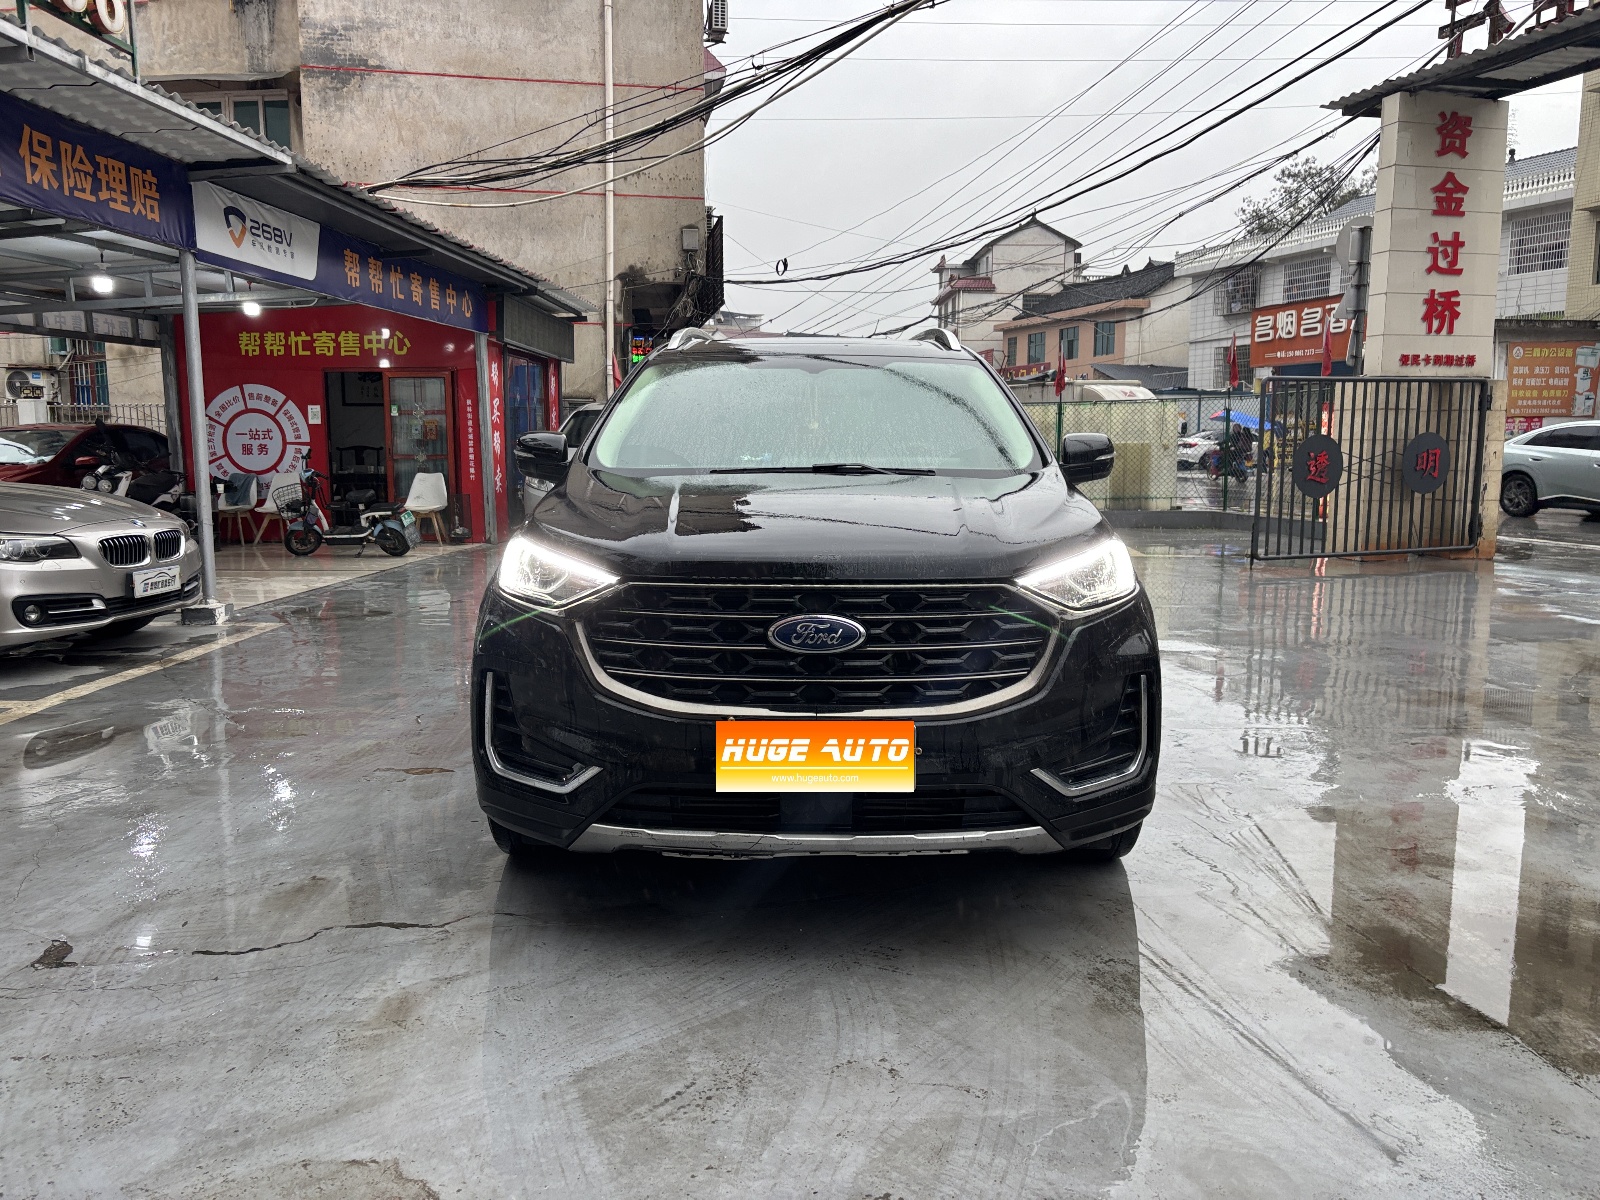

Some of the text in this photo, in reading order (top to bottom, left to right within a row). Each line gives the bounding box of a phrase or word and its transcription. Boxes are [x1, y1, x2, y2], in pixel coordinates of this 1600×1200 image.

[18, 123, 161, 222] 保险理赔
[250, 217, 293, 248] 268V
[1421, 111, 1473, 335] 资金过桥
[343, 248, 473, 318] 帮帮忙寄售中心
[238, 330, 411, 357] 帮帮忙寄售中心
[214, 395, 241, 419] 全国比价
[235, 428, 273, 441] 一站式
[241, 443, 269, 456] 服务
[1306, 450, 1331, 484] 透
[1415, 447, 1441, 479] 明
[791, 622, 842, 645] Ford
